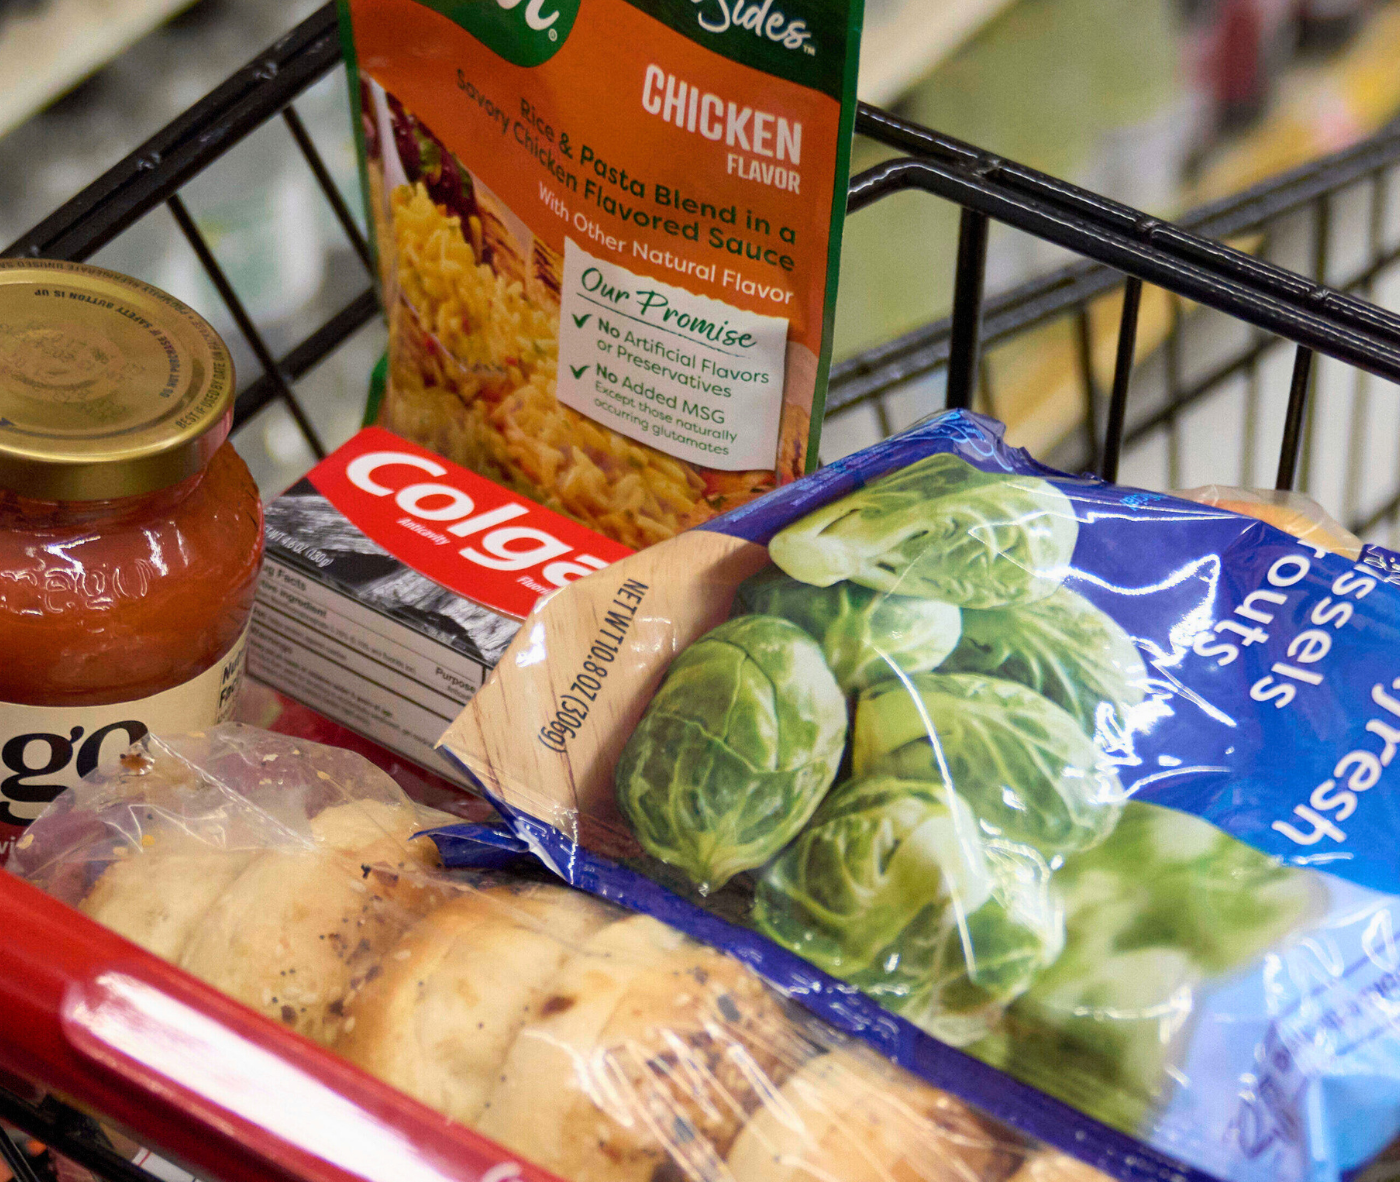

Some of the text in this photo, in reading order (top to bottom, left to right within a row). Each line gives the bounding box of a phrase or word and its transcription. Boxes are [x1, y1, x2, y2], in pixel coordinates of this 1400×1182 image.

[642, 64, 802, 165] CHICKEN
[456, 68, 796, 272] Savory Chicken Flavored Sauce
[520, 98, 796, 245] Rice & Pasta Blend in a
[727, 153, 801, 195] FLAVOR
[538, 181, 794, 305] With Other Natural Flavor
[18, 261, 64, 270] UNUSED
[35, 288, 49, 297] UP
[54, 290, 66, 299] IS
[69, 292, 114, 309] BUTTON
[581, 267, 757, 349] Our Promise
[115, 307, 153, 329] SAFETY
[158, 336, 180, 372] PURCHASE
[213, 362, 226, 379] DATE
[597, 339, 732, 398] or Preservatives
[598, 318, 770, 384] No Artificial Flavors
[202, 390, 220, 408] USED
[212, 380, 223, 391] BY
[595, 363, 725, 424] No Added MSG
[175, 411, 195, 429] BEST
[194, 405, 205, 415] IF
[594, 398, 730, 456] occurring glutamates
[595, 381, 738, 443] Except those naturally
[346, 451, 613, 588] Colga
[306, 545, 334, 568] (130g)
[396, 518, 551, 595] Anticavity Fluori
[277, 568, 306, 591] Facts
[280, 586, 327, 618] ingredient
[1250, 563, 1377, 709] ssels
[435, 667, 476, 693] Purpose
[538, 578, 649, 753] NET WT 10.8 OZ (306g)
